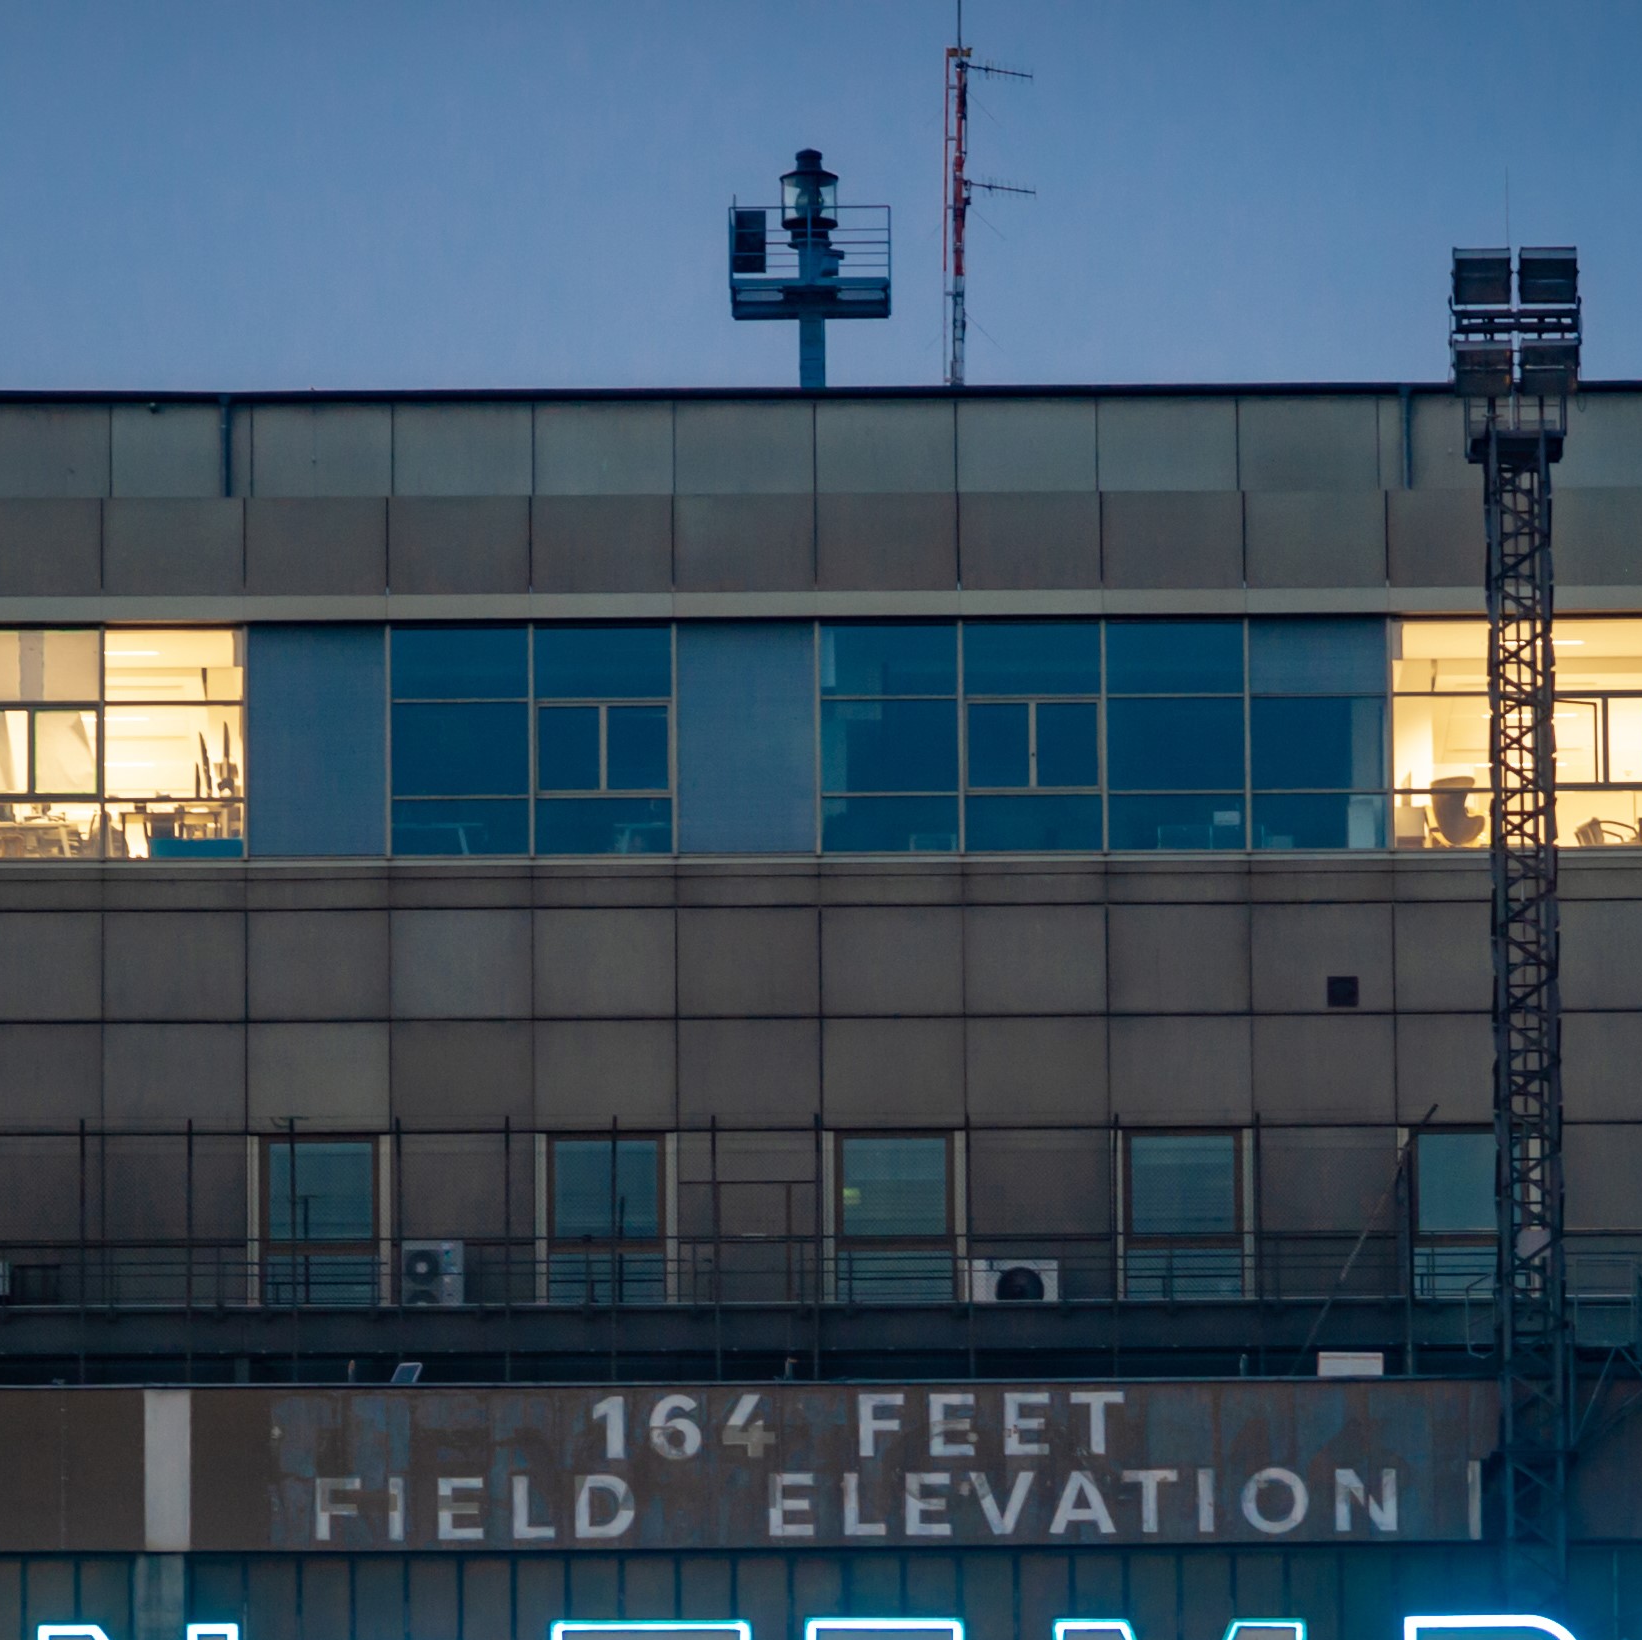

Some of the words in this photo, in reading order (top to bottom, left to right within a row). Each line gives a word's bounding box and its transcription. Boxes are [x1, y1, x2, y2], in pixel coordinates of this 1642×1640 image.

[592, 1393, 776, 1459] 164
[858, 1391, 1125, 1457] FEET
[315, 1474, 636, 1541] FIELD
[769, 1466, 1399, 1537] ELEVATION
